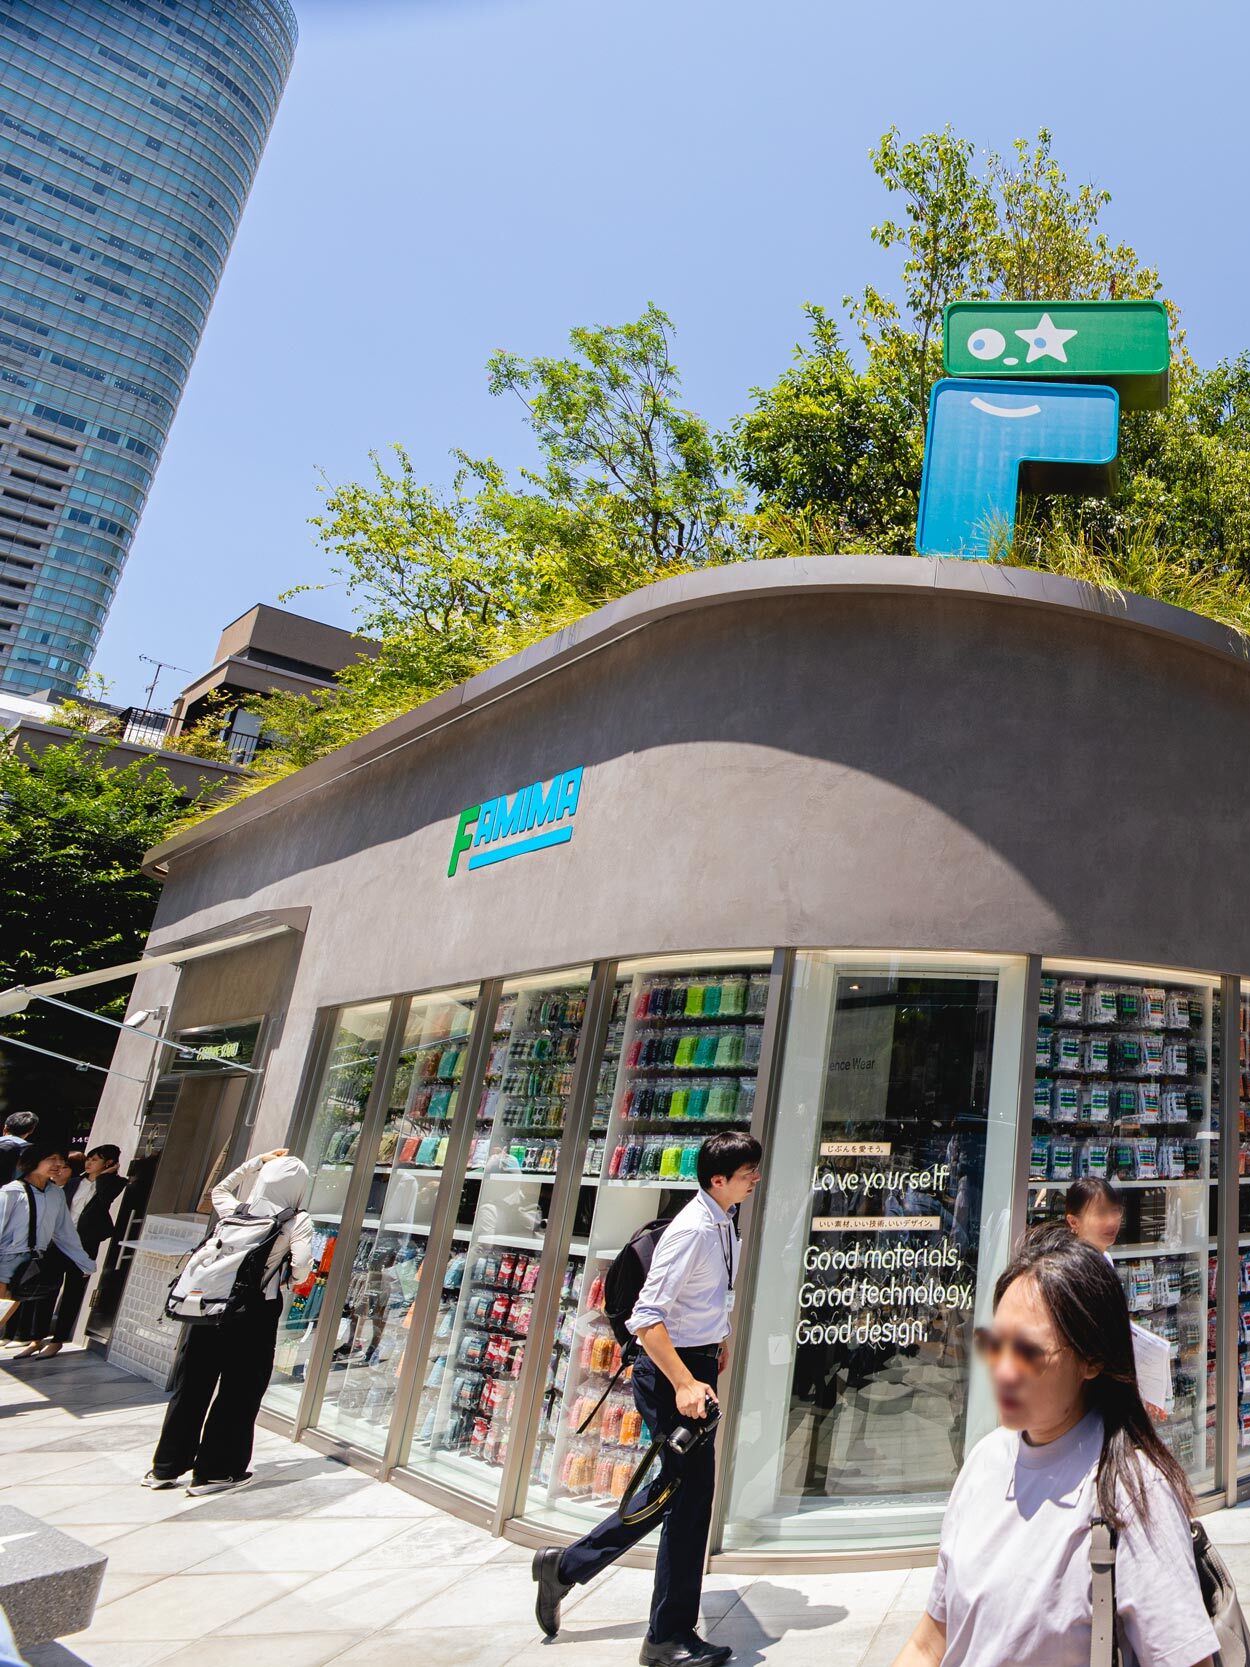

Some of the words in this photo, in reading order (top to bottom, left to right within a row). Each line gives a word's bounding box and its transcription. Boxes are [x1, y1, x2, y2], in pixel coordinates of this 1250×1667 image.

[447, 765, 584, 878] FAMIMA
[852, 1057, 875, 1070] Wear
[826, 1144, 885, 1154] じぶんを愛そう。
[811, 1164, 859, 1191] Love
[862, 1163, 950, 1196] yourself
[803, 1242, 860, 1271] Good
[863, 1239, 962, 1272] materials,
[798, 1278, 856, 1308] Good
[858, 1277, 973, 1309] technology,
[796, 1314, 853, 1345] Good
[855, 1314, 929, 1347] design.
